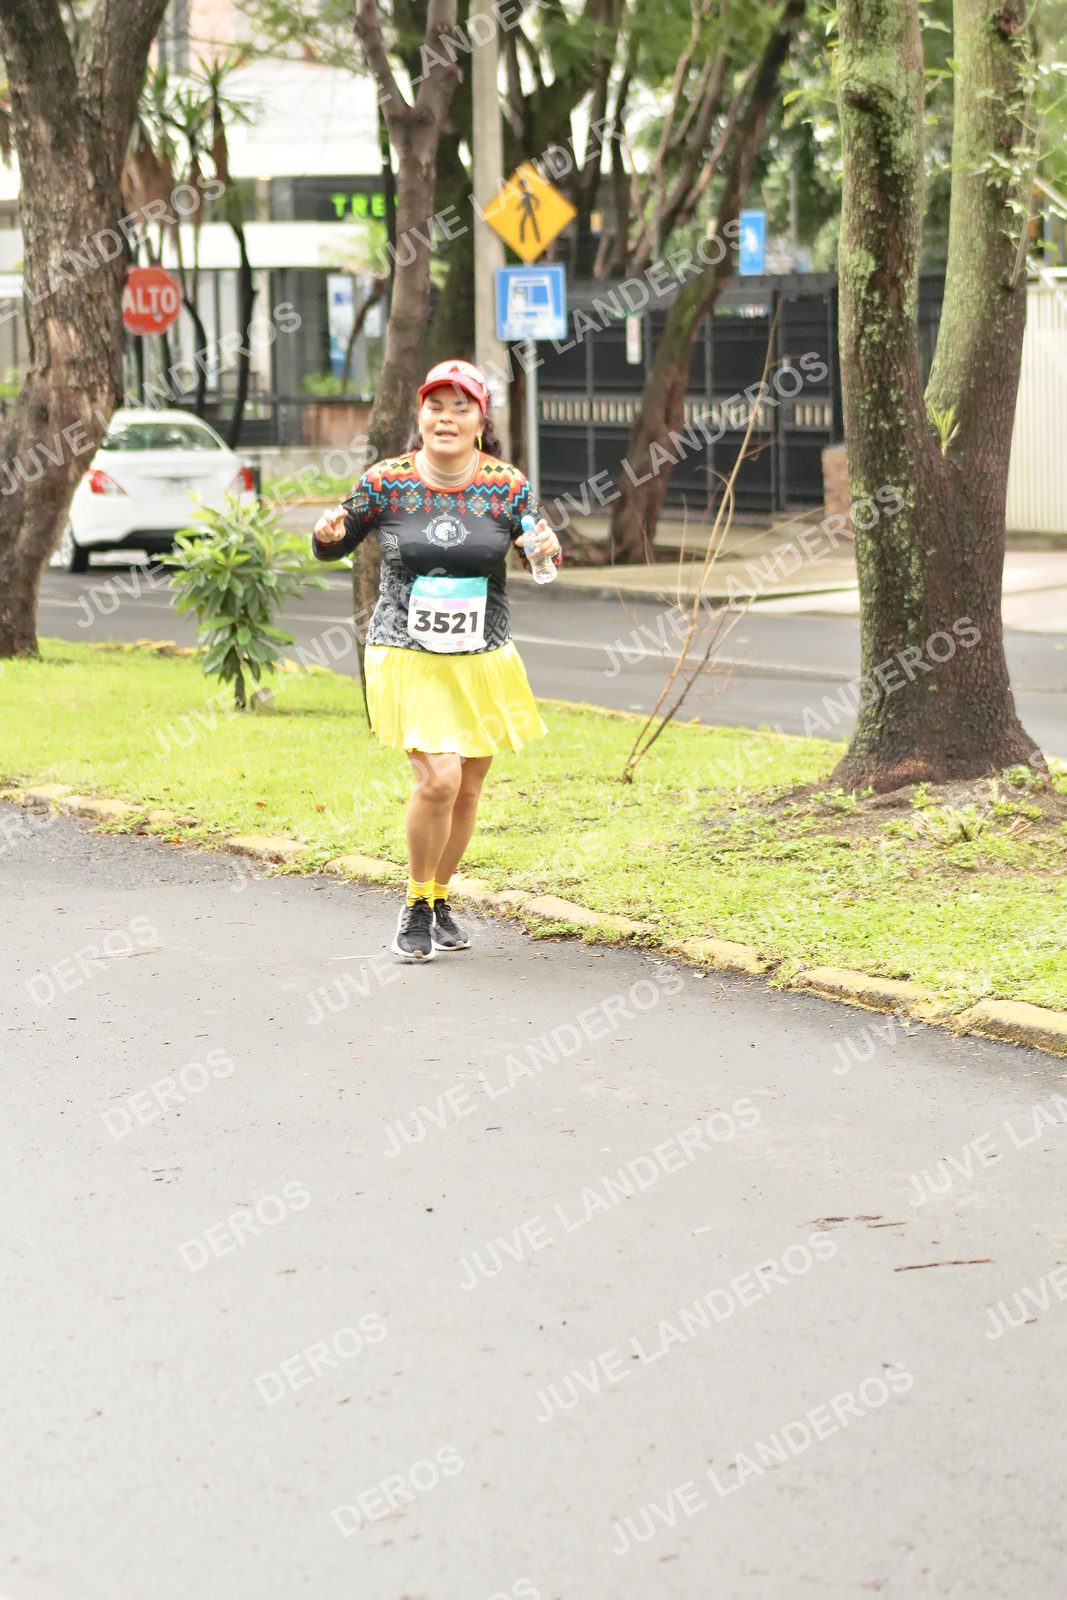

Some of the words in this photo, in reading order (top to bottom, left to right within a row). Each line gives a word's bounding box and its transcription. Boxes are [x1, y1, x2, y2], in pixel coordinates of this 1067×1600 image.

[331, 192, 398, 217] TRE
[121, 287, 177, 315] ALTO
[414, 610, 478, 634] 3521
